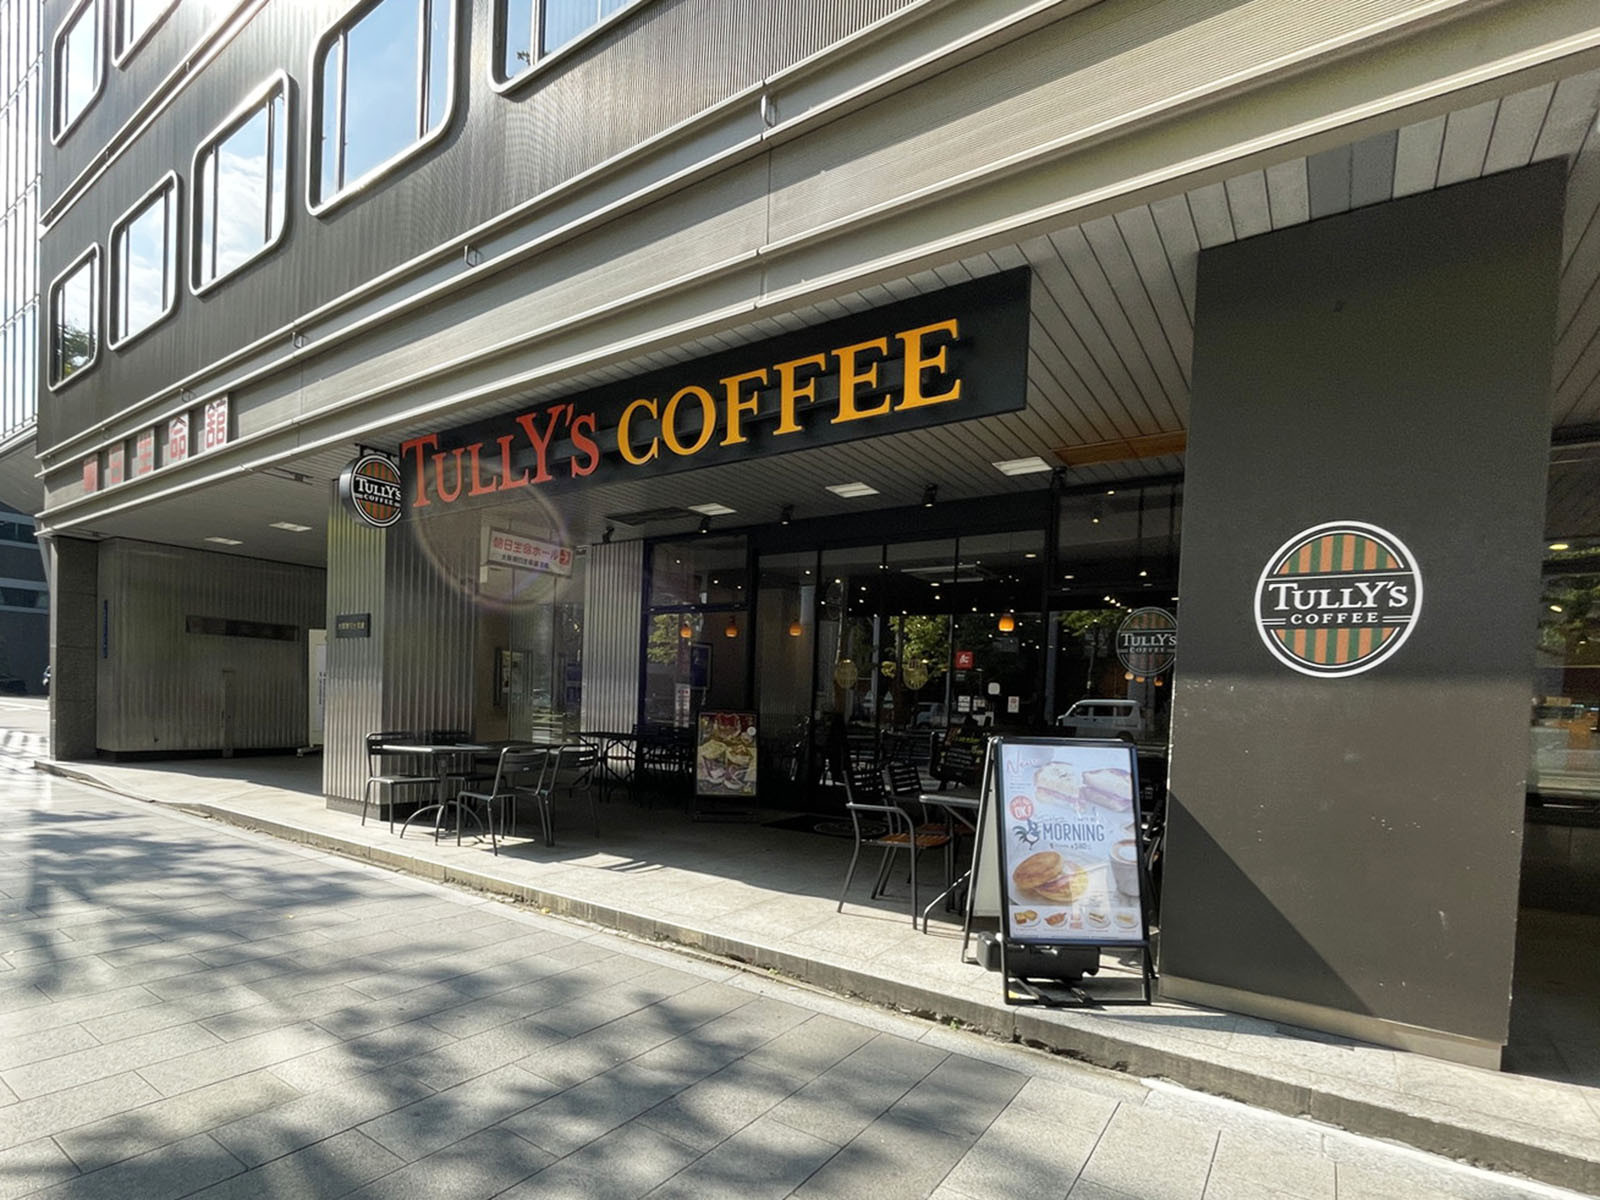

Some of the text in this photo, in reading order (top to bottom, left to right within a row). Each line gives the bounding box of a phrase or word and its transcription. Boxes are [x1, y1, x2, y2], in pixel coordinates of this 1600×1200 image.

[402, 318, 962, 508] TULLY'S COFFEE
[355, 476, 401, 501] TULLY'S
[363, 493, 394, 506] COFFEE
[1268, 580, 1408, 611] TULLY'S
[1290, 612, 1379, 625] COFFEE
[1120, 633, 1177, 646] TULLY'S
[1042, 823, 1105, 842] MORNING
